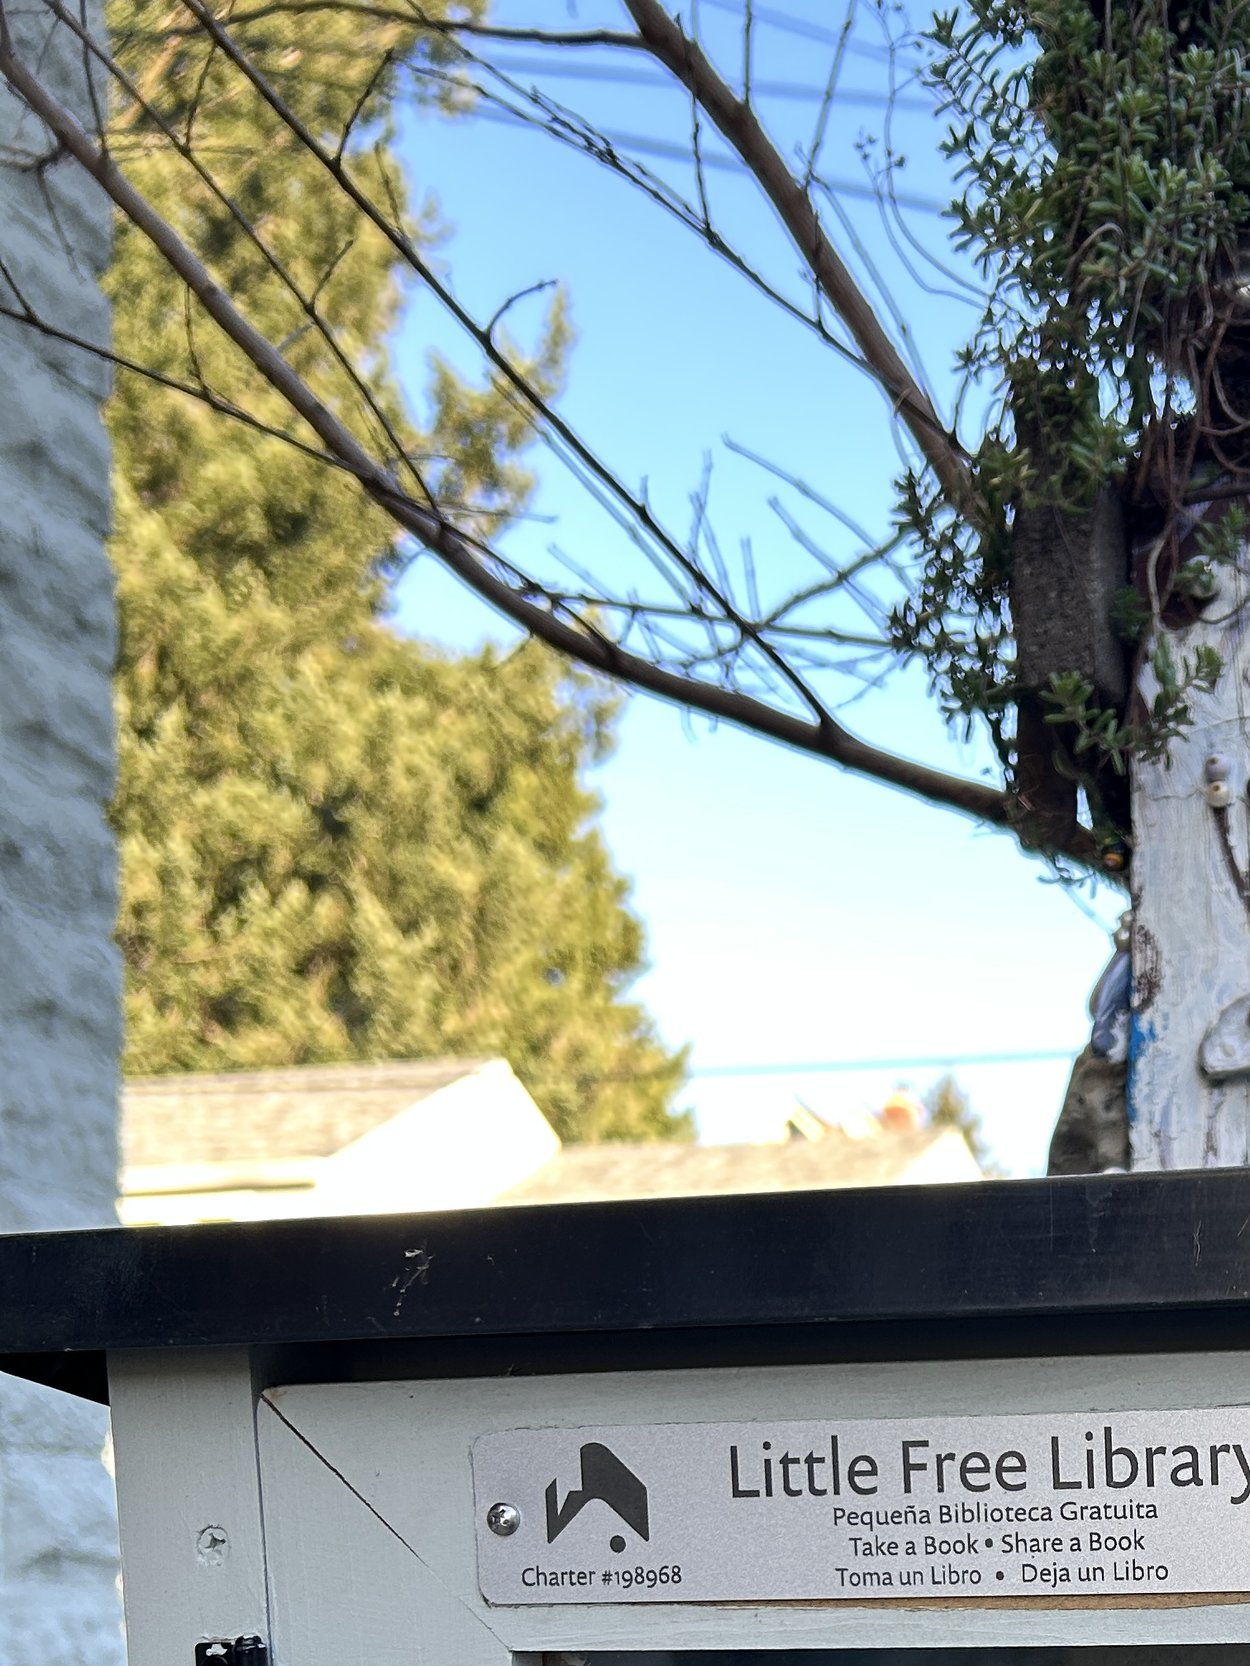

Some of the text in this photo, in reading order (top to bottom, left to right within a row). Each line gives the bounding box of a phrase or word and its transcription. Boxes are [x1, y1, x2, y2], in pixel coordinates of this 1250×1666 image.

[730, 1434, 878, 1498] Little
[902, 1439, 1027, 1494] Free
[833, 1498, 1159, 1531] Pequeña Biblioteca Gratuita
[849, 1529, 1146, 1557] Take a Book Share a Book
[521, 1565, 683, 1589] Charter #198968
[835, 1558, 1169, 1588] Toma un Libro Deja un Libro
